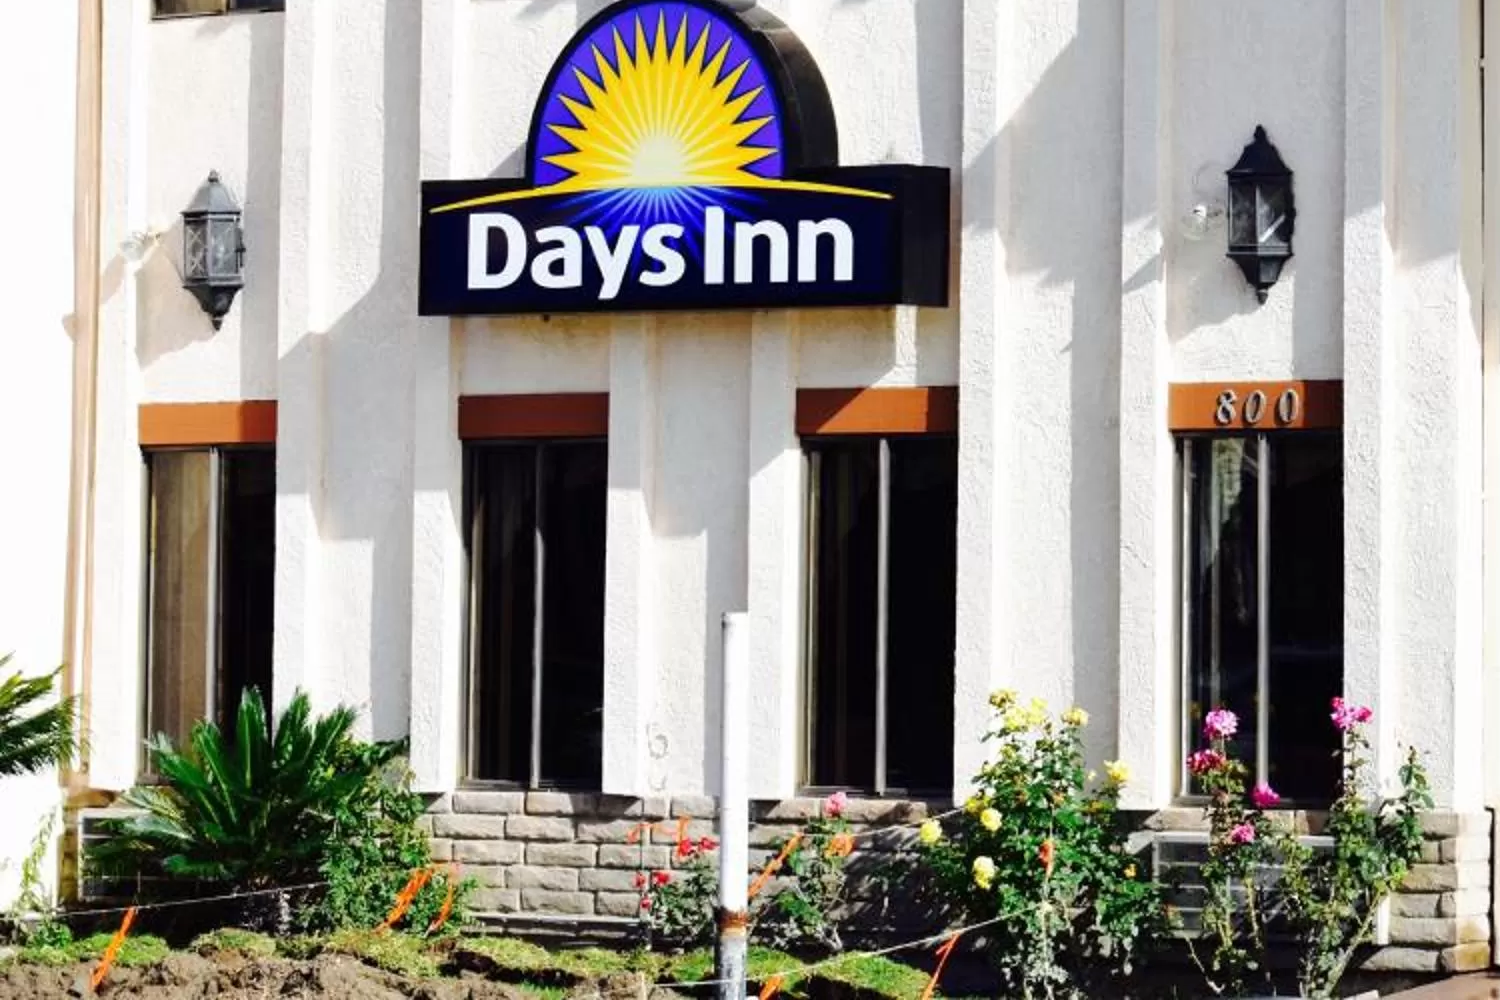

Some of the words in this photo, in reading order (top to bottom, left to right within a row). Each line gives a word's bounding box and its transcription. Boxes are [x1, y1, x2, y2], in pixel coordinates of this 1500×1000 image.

[467, 212, 686, 300] Days
[703, 205, 854, 285] Inn
[1215, 388, 1300, 424] 800
